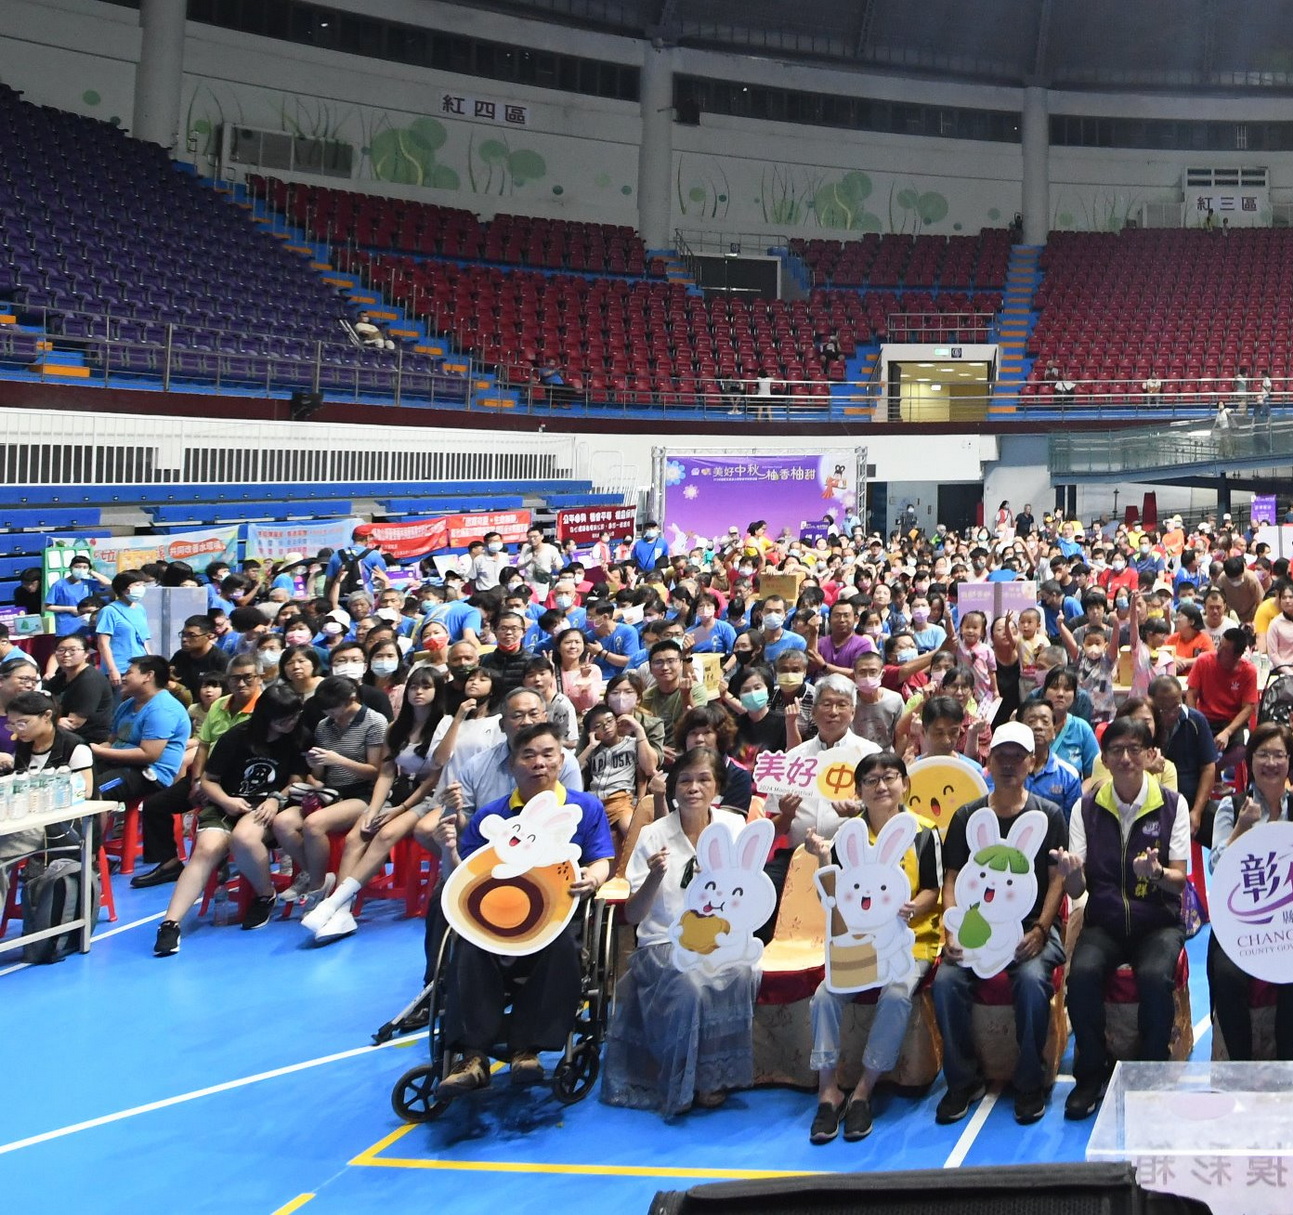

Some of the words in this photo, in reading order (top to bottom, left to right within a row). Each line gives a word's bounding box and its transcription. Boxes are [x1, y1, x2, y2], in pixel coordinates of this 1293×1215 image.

[442, 94, 527, 125] 紅四區
[1197, 195, 1258, 212] 紅三區
[712, 463, 763, 478] 美好中秋
[766, 466, 817, 481] 柚香柚甜
[611, 751, 632, 769] USA
[1239, 945, 1276, 958] COUNTY
